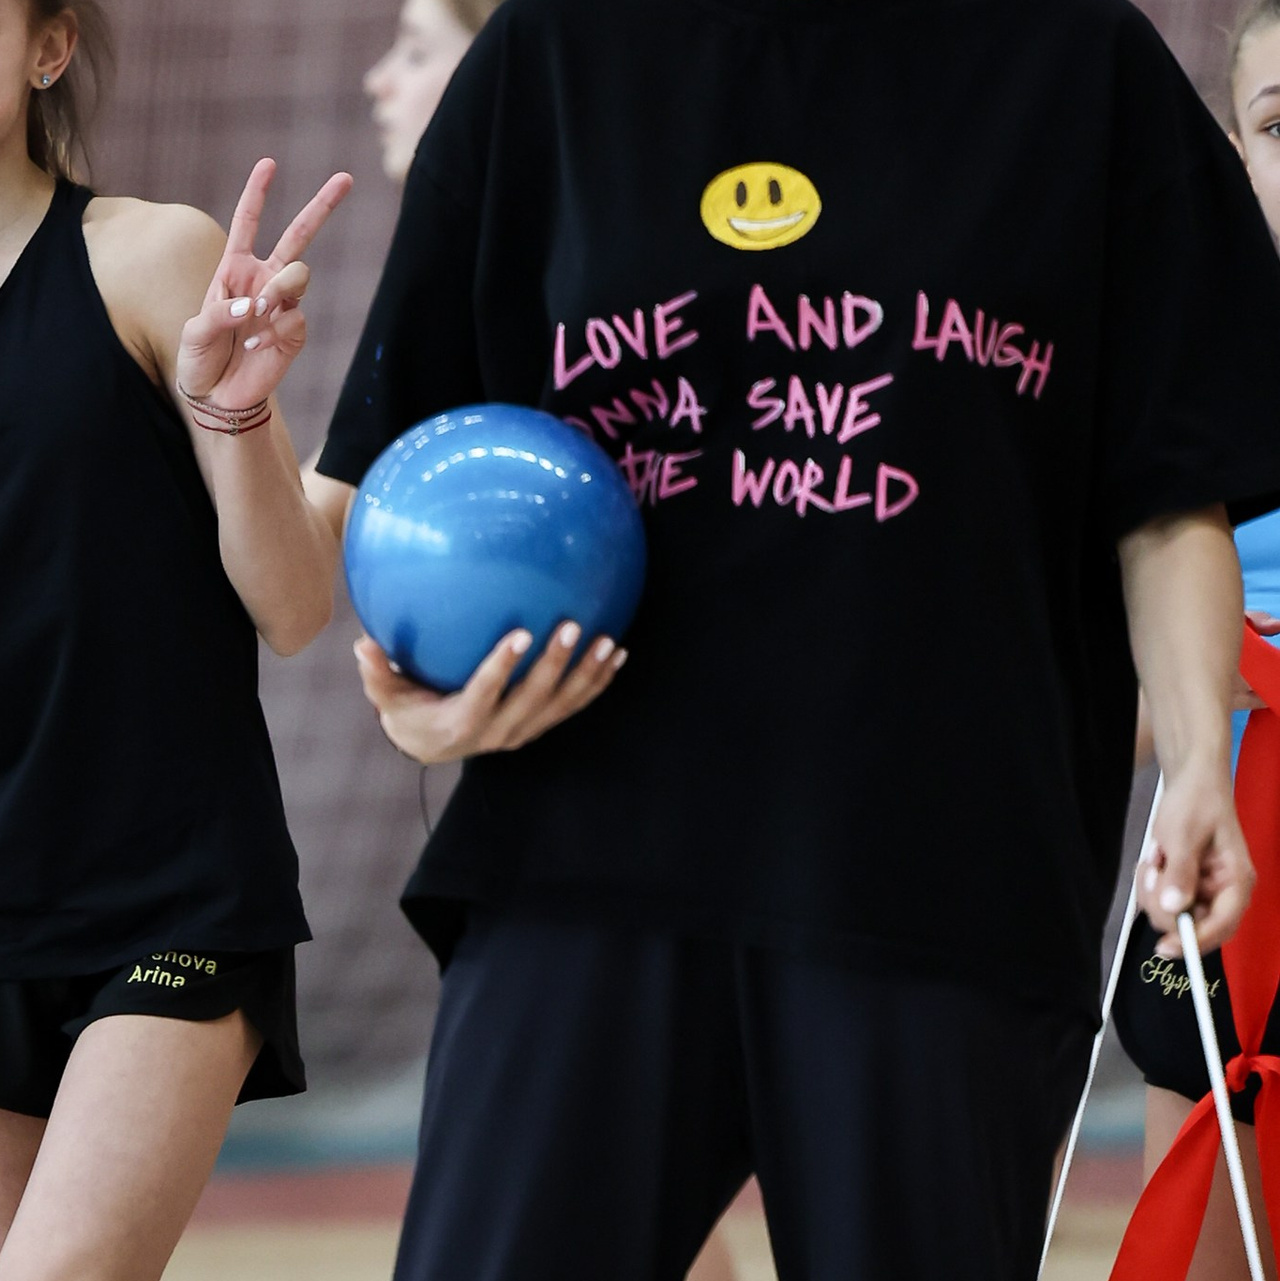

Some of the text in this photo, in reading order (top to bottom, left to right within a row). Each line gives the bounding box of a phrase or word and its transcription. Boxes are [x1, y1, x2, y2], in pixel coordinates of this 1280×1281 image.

[553, 283, 1054, 400] LOVE AND LAUGH
[746, 373, 893, 443] SAVE
[618, 442, 920, 521] THE WORLD
[126, 964, 186, 988] Arina
[1140, 953, 1221, 999] Flysprt
